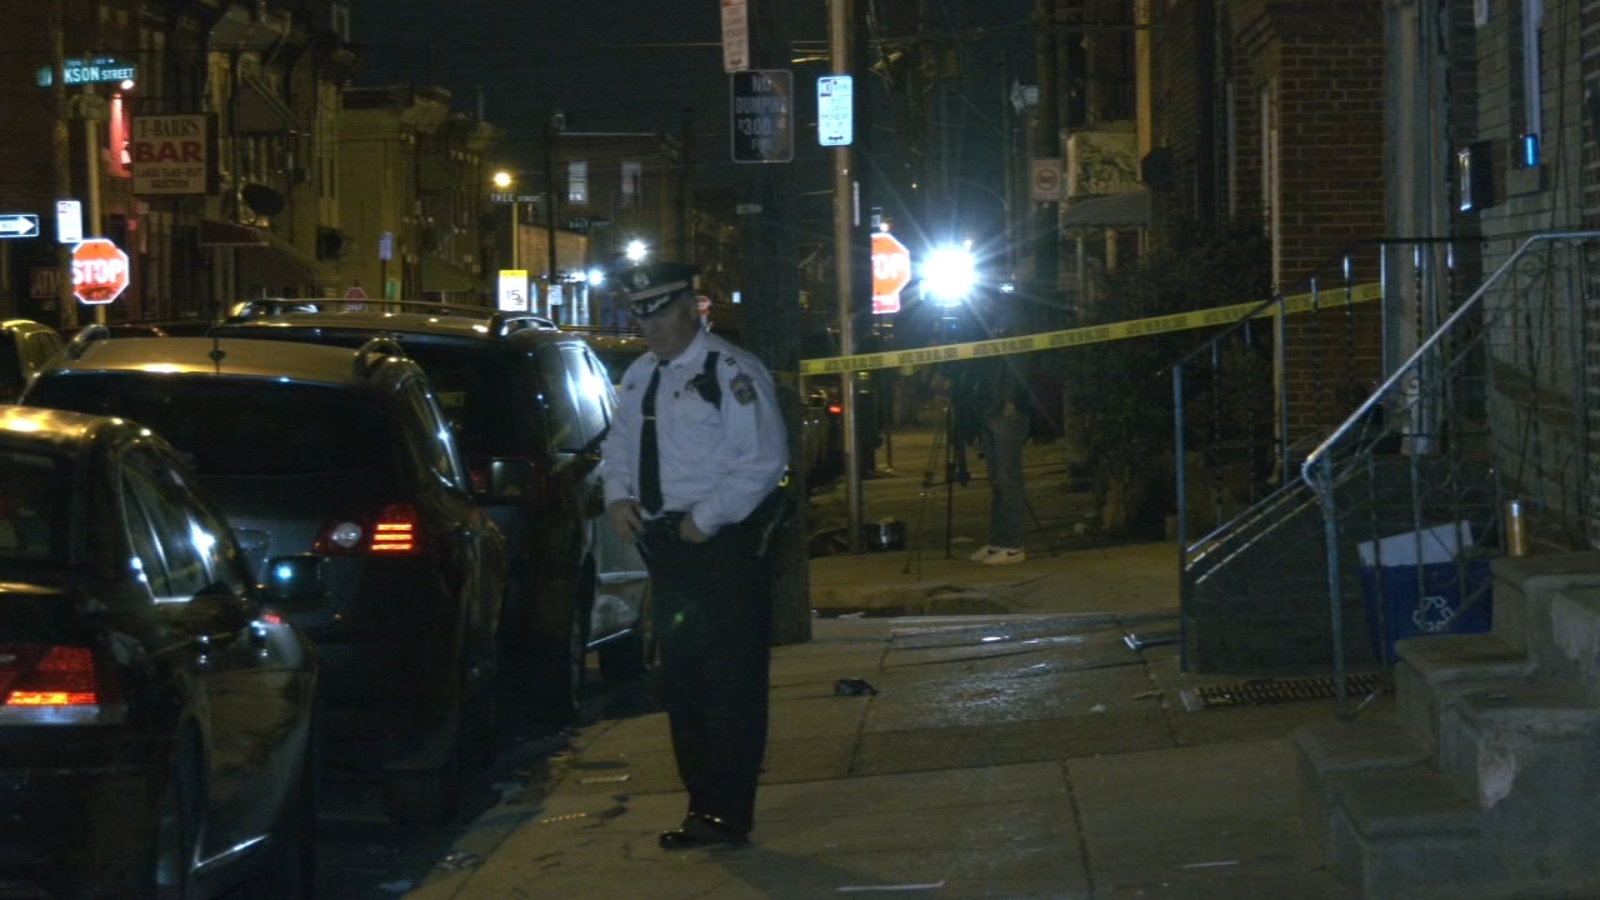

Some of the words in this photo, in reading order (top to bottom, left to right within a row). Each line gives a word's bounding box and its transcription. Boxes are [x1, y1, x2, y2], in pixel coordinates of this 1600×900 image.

[101, 69, 134, 80] STREET
[136, 141, 204, 162] BAR
[71, 259, 124, 285] STOP
[506, 290, 522, 301] 15
